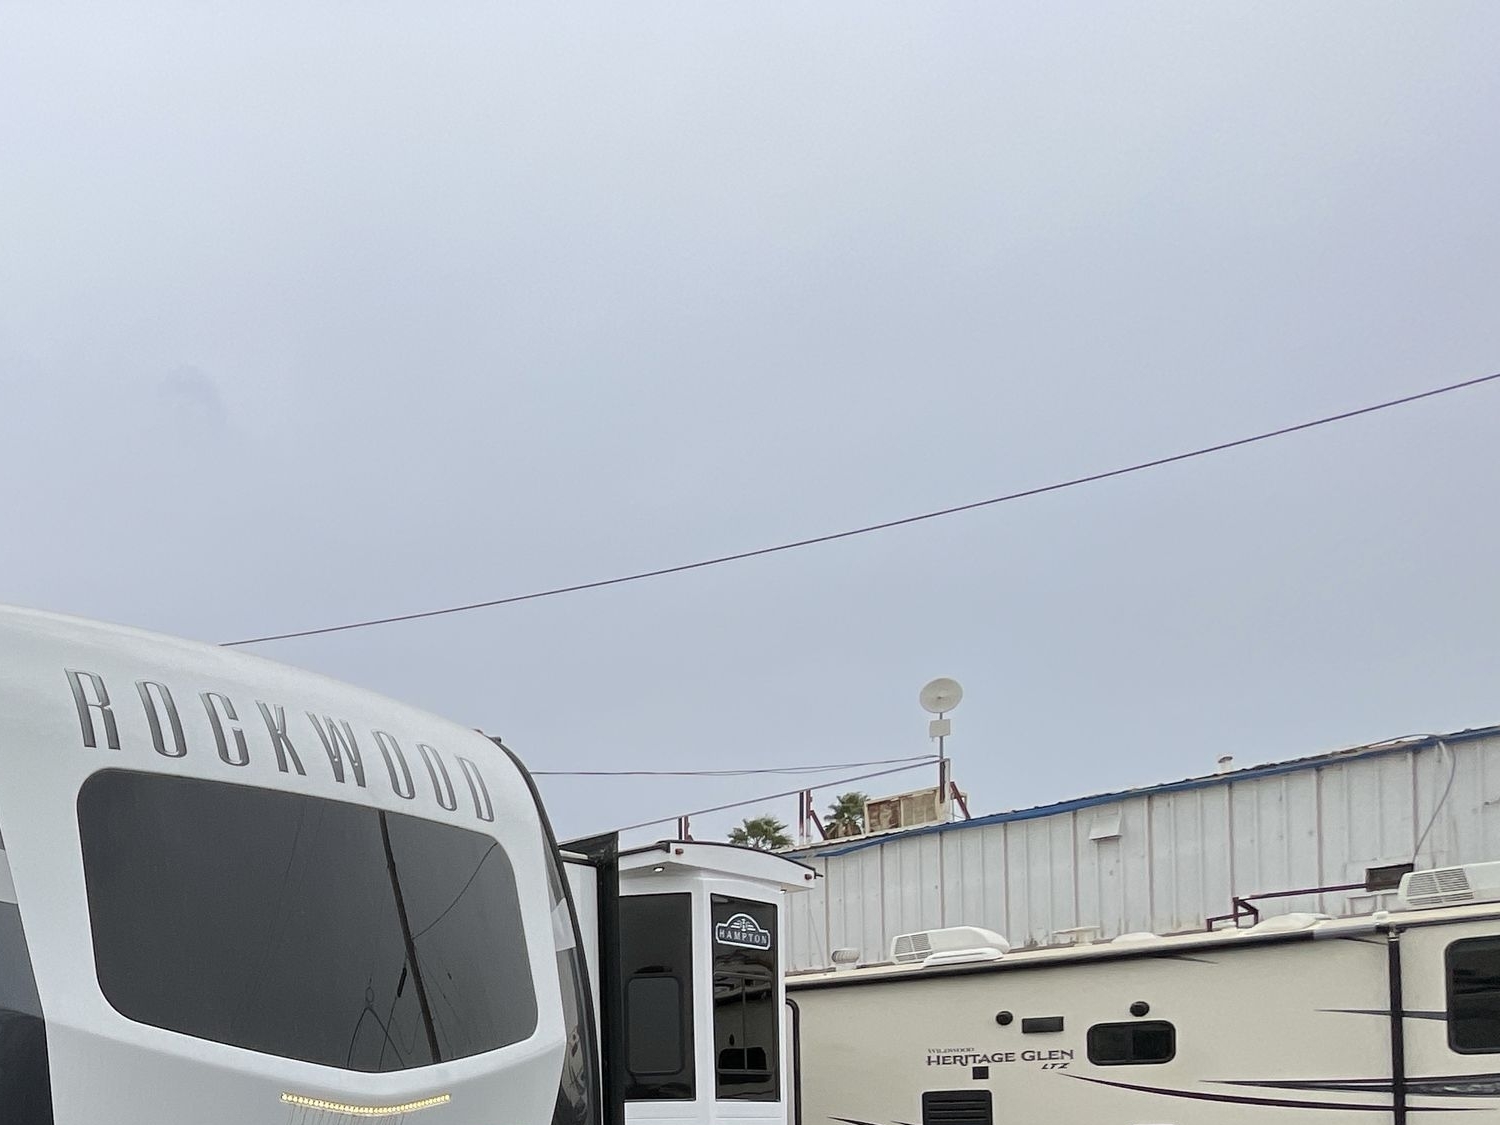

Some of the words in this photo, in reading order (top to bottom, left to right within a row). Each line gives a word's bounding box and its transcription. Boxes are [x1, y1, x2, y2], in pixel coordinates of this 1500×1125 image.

[64, 667, 495, 823] ROCKWOOD
[719, 929, 767, 944] HAMPTON
[927, 1052, 1016, 1066] HERITAGE
[1021, 1049, 1075, 1062] GLEN
